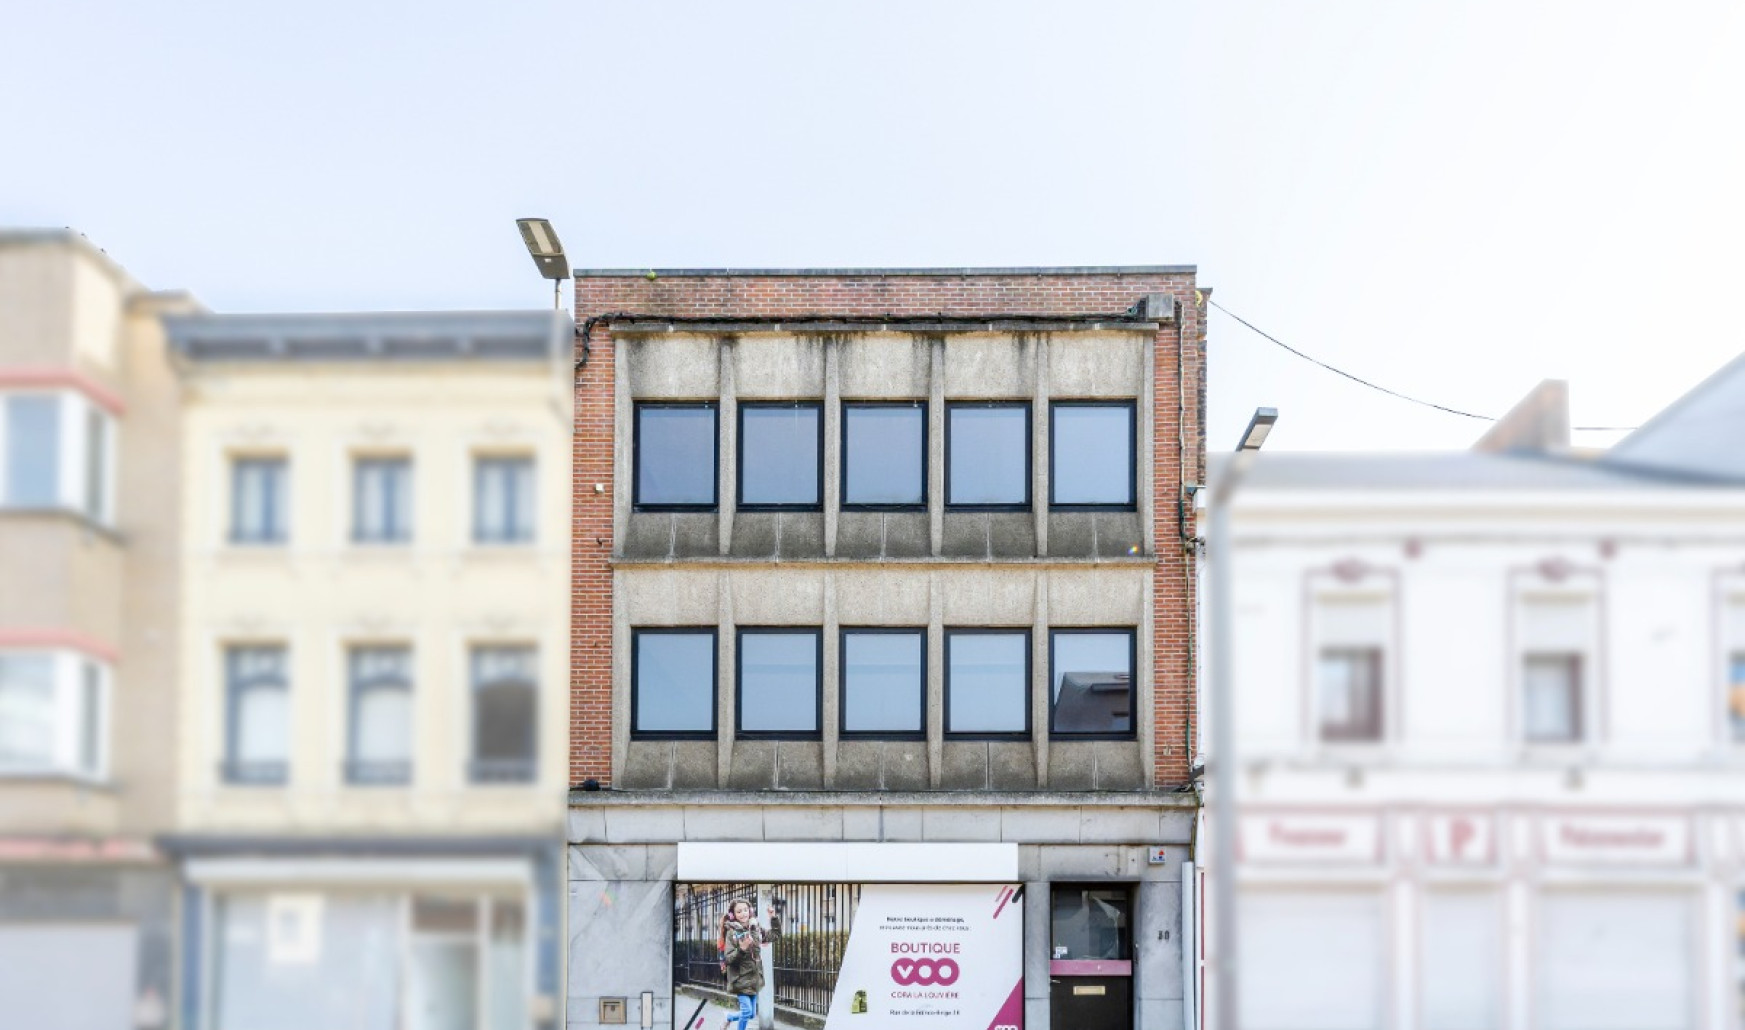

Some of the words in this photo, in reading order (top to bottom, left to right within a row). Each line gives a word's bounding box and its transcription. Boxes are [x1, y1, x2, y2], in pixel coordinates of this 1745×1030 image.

[891, 942, 961, 954] BOUTIQUE
[890, 991, 913, 999] CORA
[913, 991, 923, 999] LA
